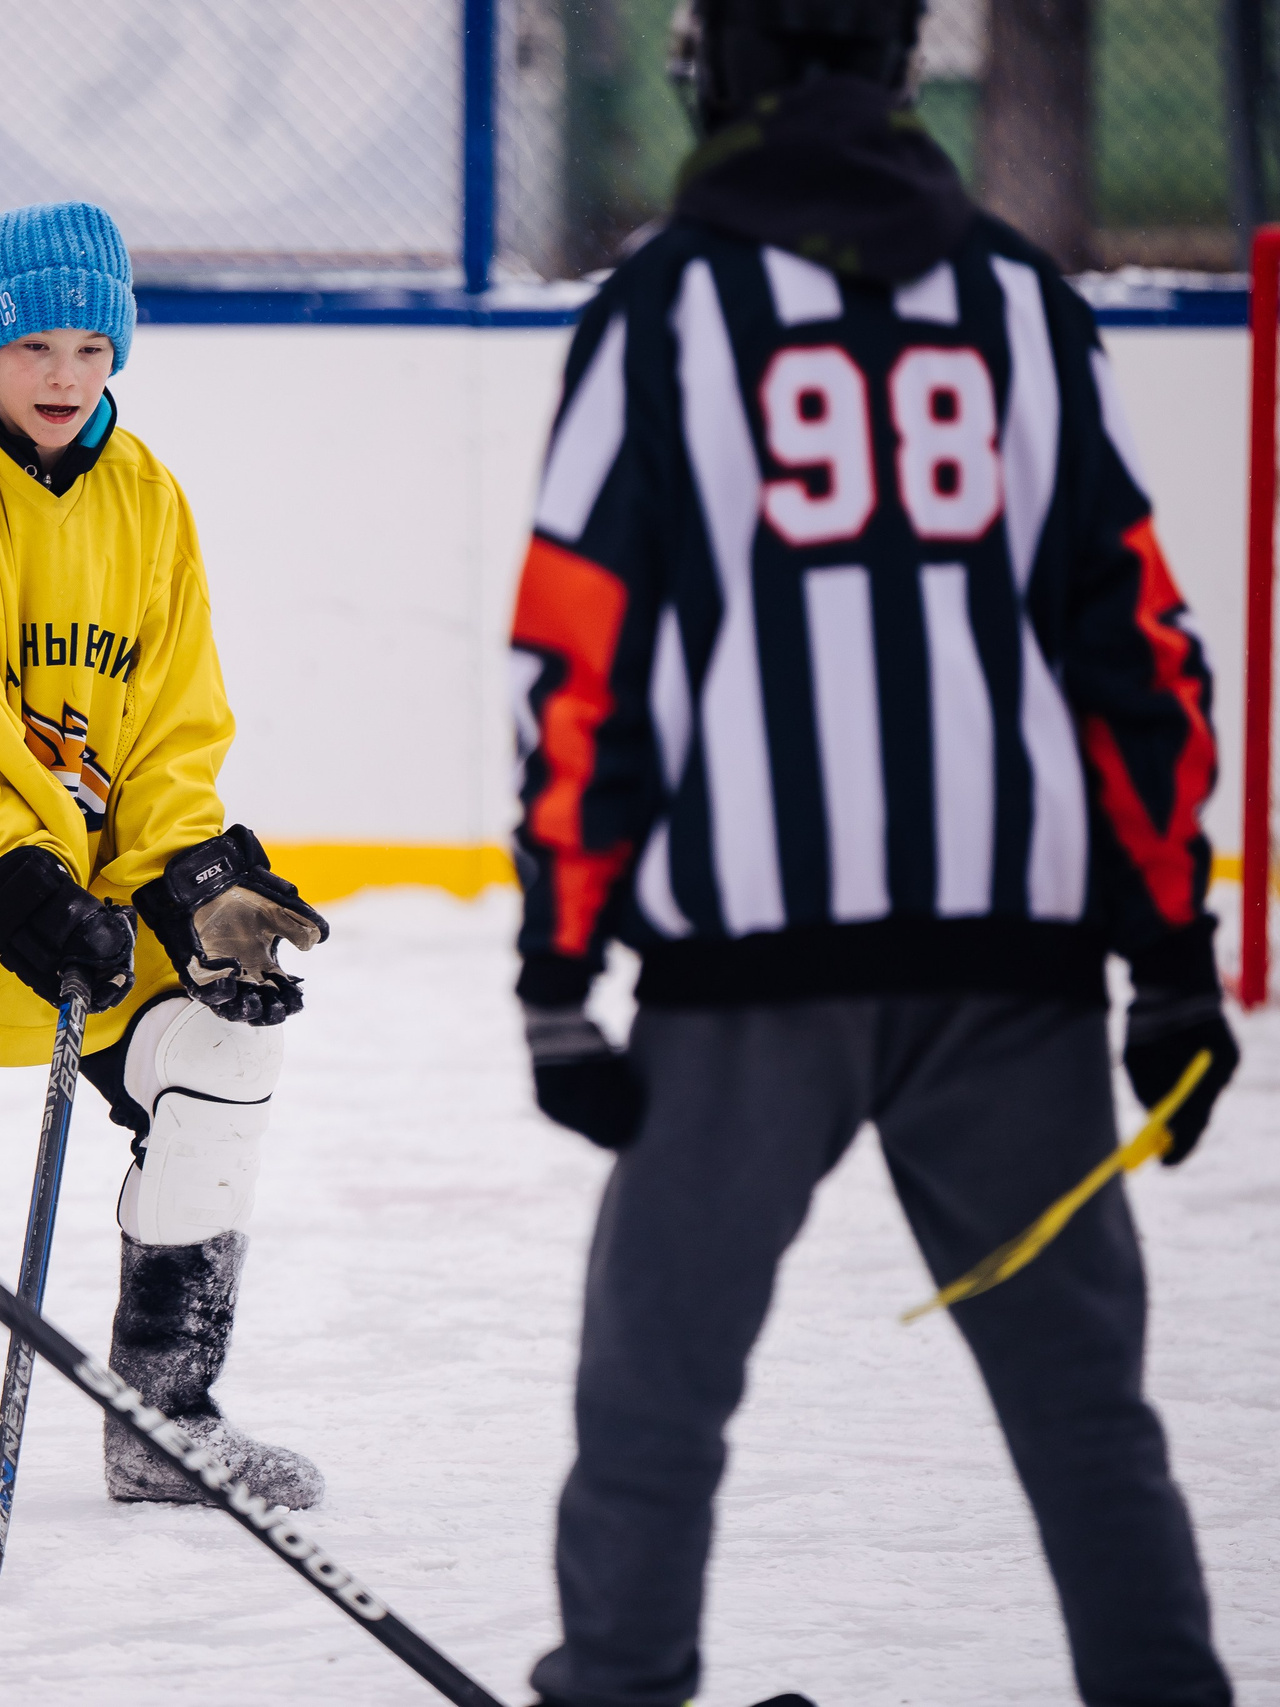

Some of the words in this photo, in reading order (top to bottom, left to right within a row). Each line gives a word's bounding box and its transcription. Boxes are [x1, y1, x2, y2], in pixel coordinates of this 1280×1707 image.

[758, 344, 1006, 546] 98
[195, 863, 223, 885] STEX
[72, 1359, 389, 1622] SHER-WOOD
